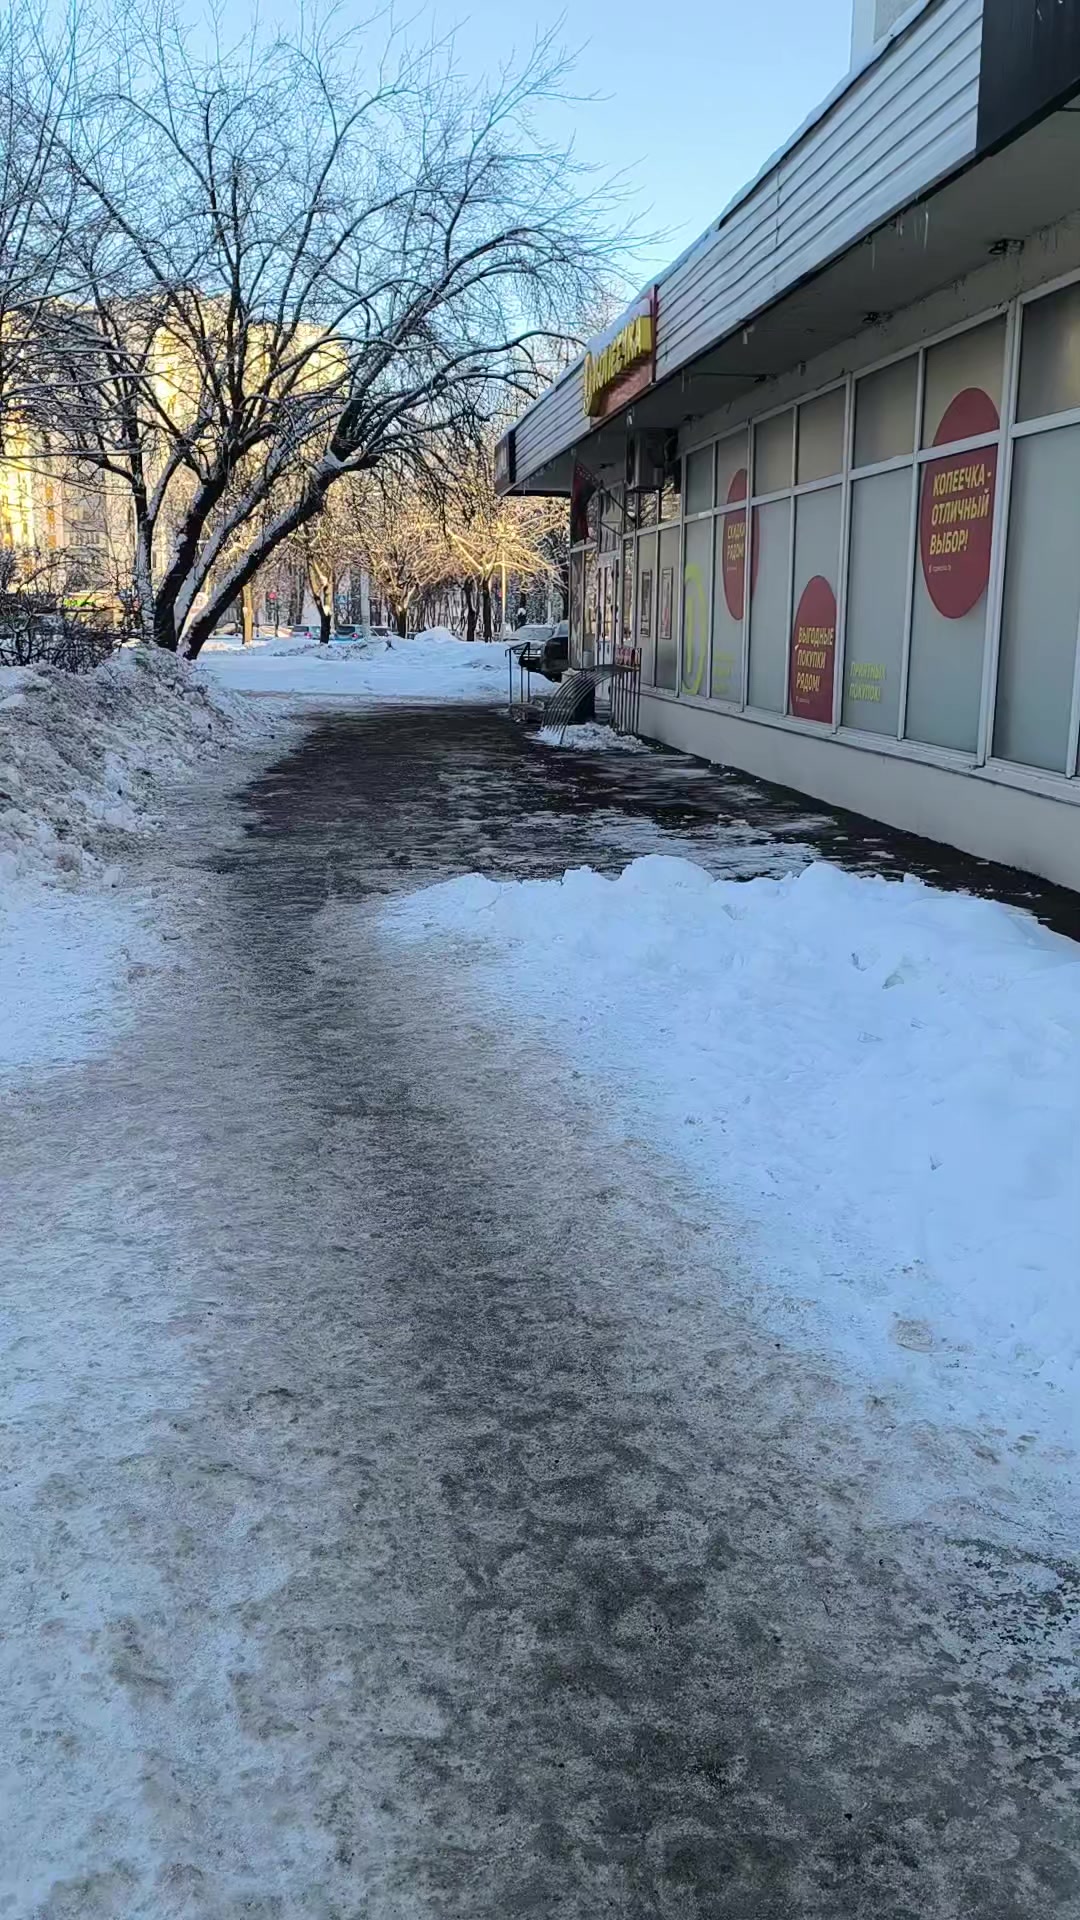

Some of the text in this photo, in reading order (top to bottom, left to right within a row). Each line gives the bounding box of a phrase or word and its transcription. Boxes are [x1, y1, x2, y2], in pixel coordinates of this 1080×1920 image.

[932, 463, 985, 496] КОПЕЕЧКА
[931, 488, 990, 526] ОТЛИЧНЫЙ
[930, 529, 968, 555] ВЫБОР!
[798, 627, 834, 647] ВЫГОДНЫЕ
[797, 650, 826, 669] ПОКУПКИ
[796, 672, 821, 692] РЯДОМ!
